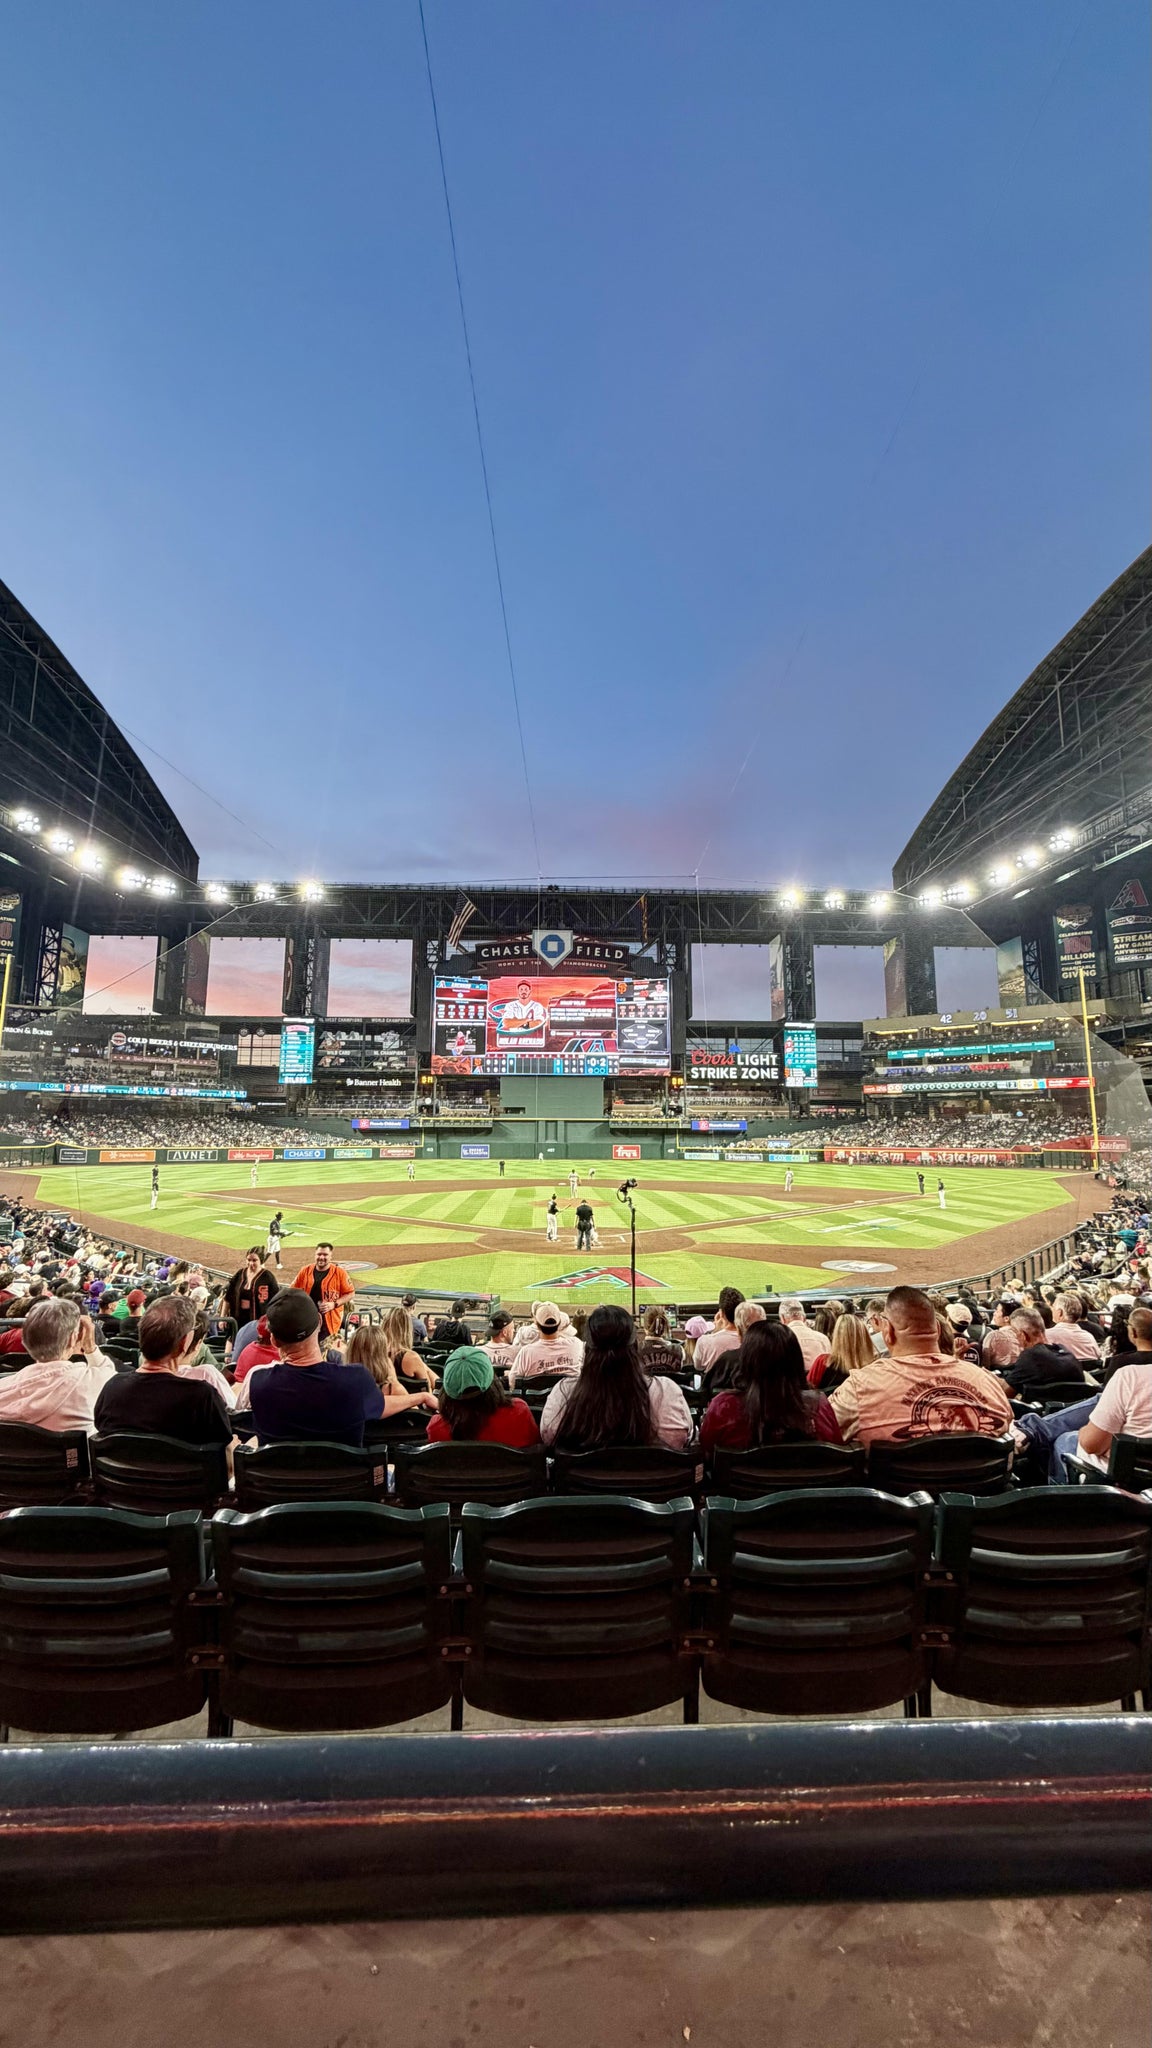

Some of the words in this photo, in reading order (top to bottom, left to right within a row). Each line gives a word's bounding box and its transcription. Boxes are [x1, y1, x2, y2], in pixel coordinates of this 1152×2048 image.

[1058, 930, 1093, 938] CELEBRATING
[481, 945, 529, 958] CHASE
[576, 946, 624, 959] FIELD
[1060, 952, 1096, 961] MILLION
[563, 961, 607, 969] DIAMONDBACKS
[1062, 970, 1097, 979] GIVNG
[940, 1014, 952, 1023] 42
[973, 1011, 987, 1021] 20
[149, 1038, 172, 1046] BEERS
[179, 1041, 238, 1050] CHEESEBURGERS
[690, 1048, 735, 1065] Coors
[737, 1054, 778, 1065] LIGHT
[691, 1067, 738, 1079] STRIKE
[741, 1068, 779, 1079] ZONE
[379, 1078, 402, 1086] Health
[172, 1151, 213, 1160] AVNET
[490, 1355, 511, 1367] ARTE
[642, 1353, 681, 1371] RIZONA
